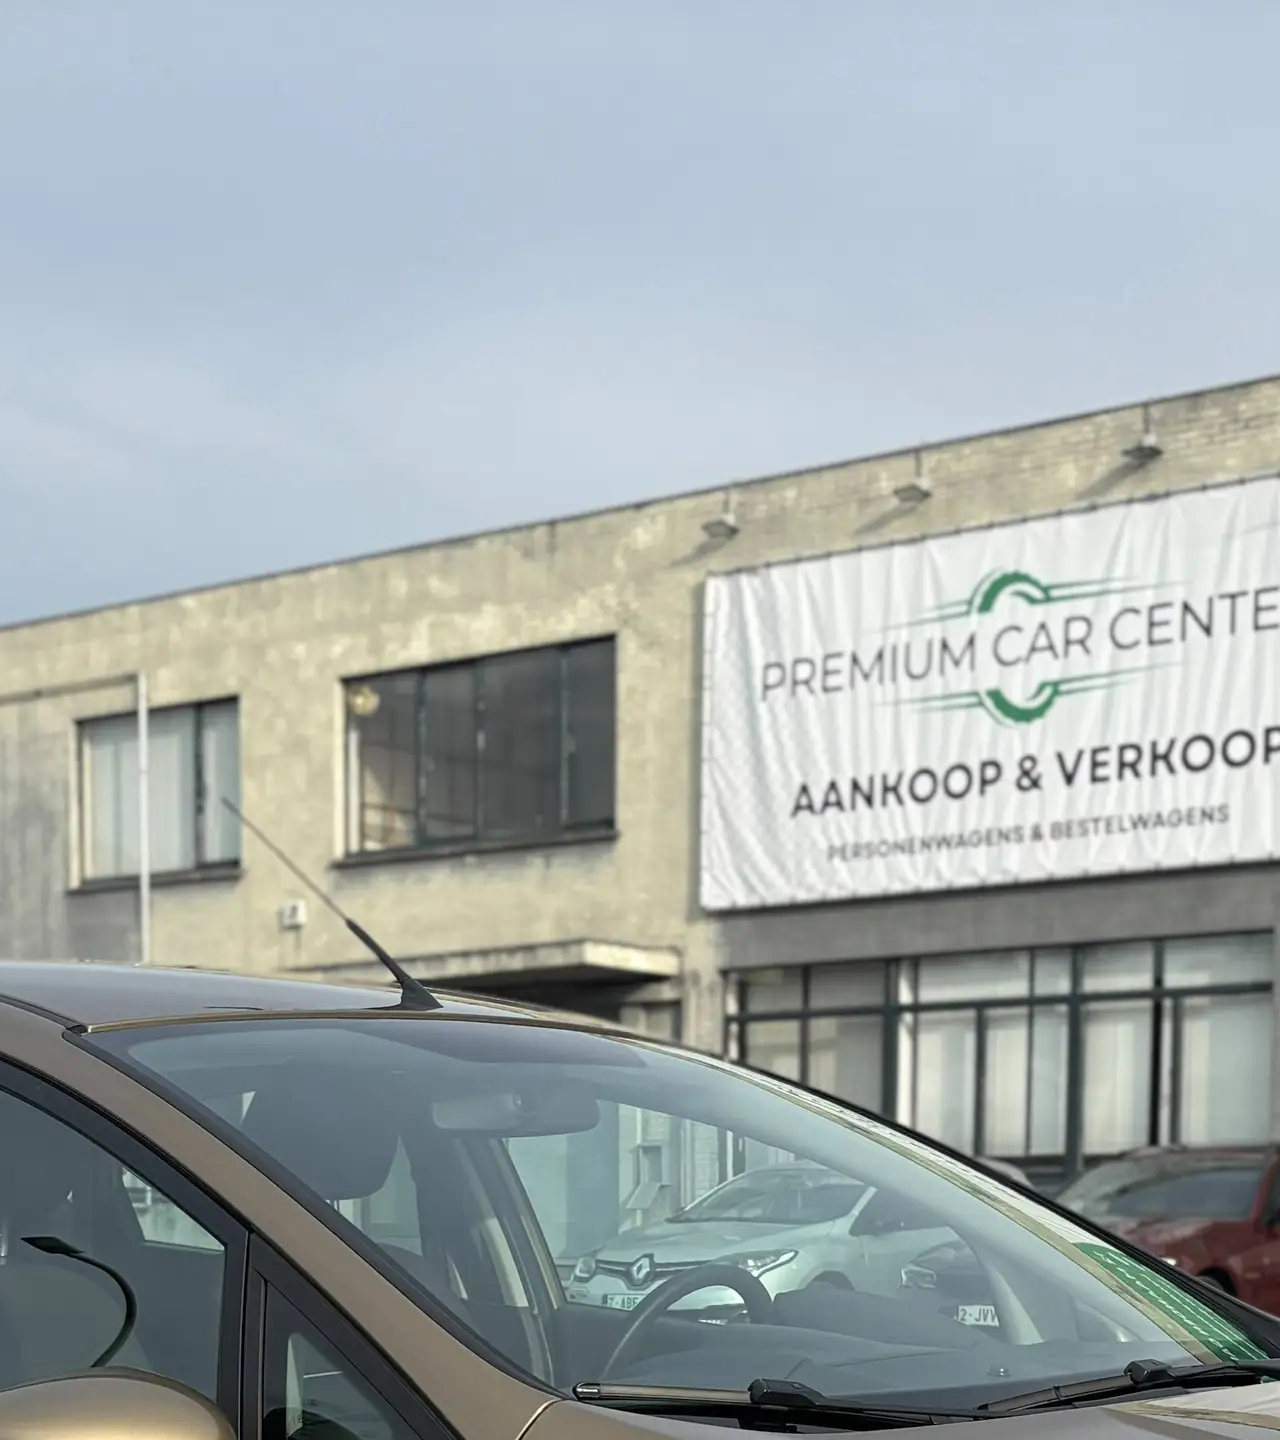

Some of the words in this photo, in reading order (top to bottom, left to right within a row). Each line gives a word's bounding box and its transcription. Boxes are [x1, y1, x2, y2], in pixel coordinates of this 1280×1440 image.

[761, 631, 978, 700] PREMIUM
[991, 614, 1094, 668] CAR
[789, 759, 1004, 818] AANKOOP
[1016, 755, 1042, 793] &
[827, 825, 1024, 862] PERSONENWAGENS
[1049, 804, 1230, 841] BESTELWAGENS
